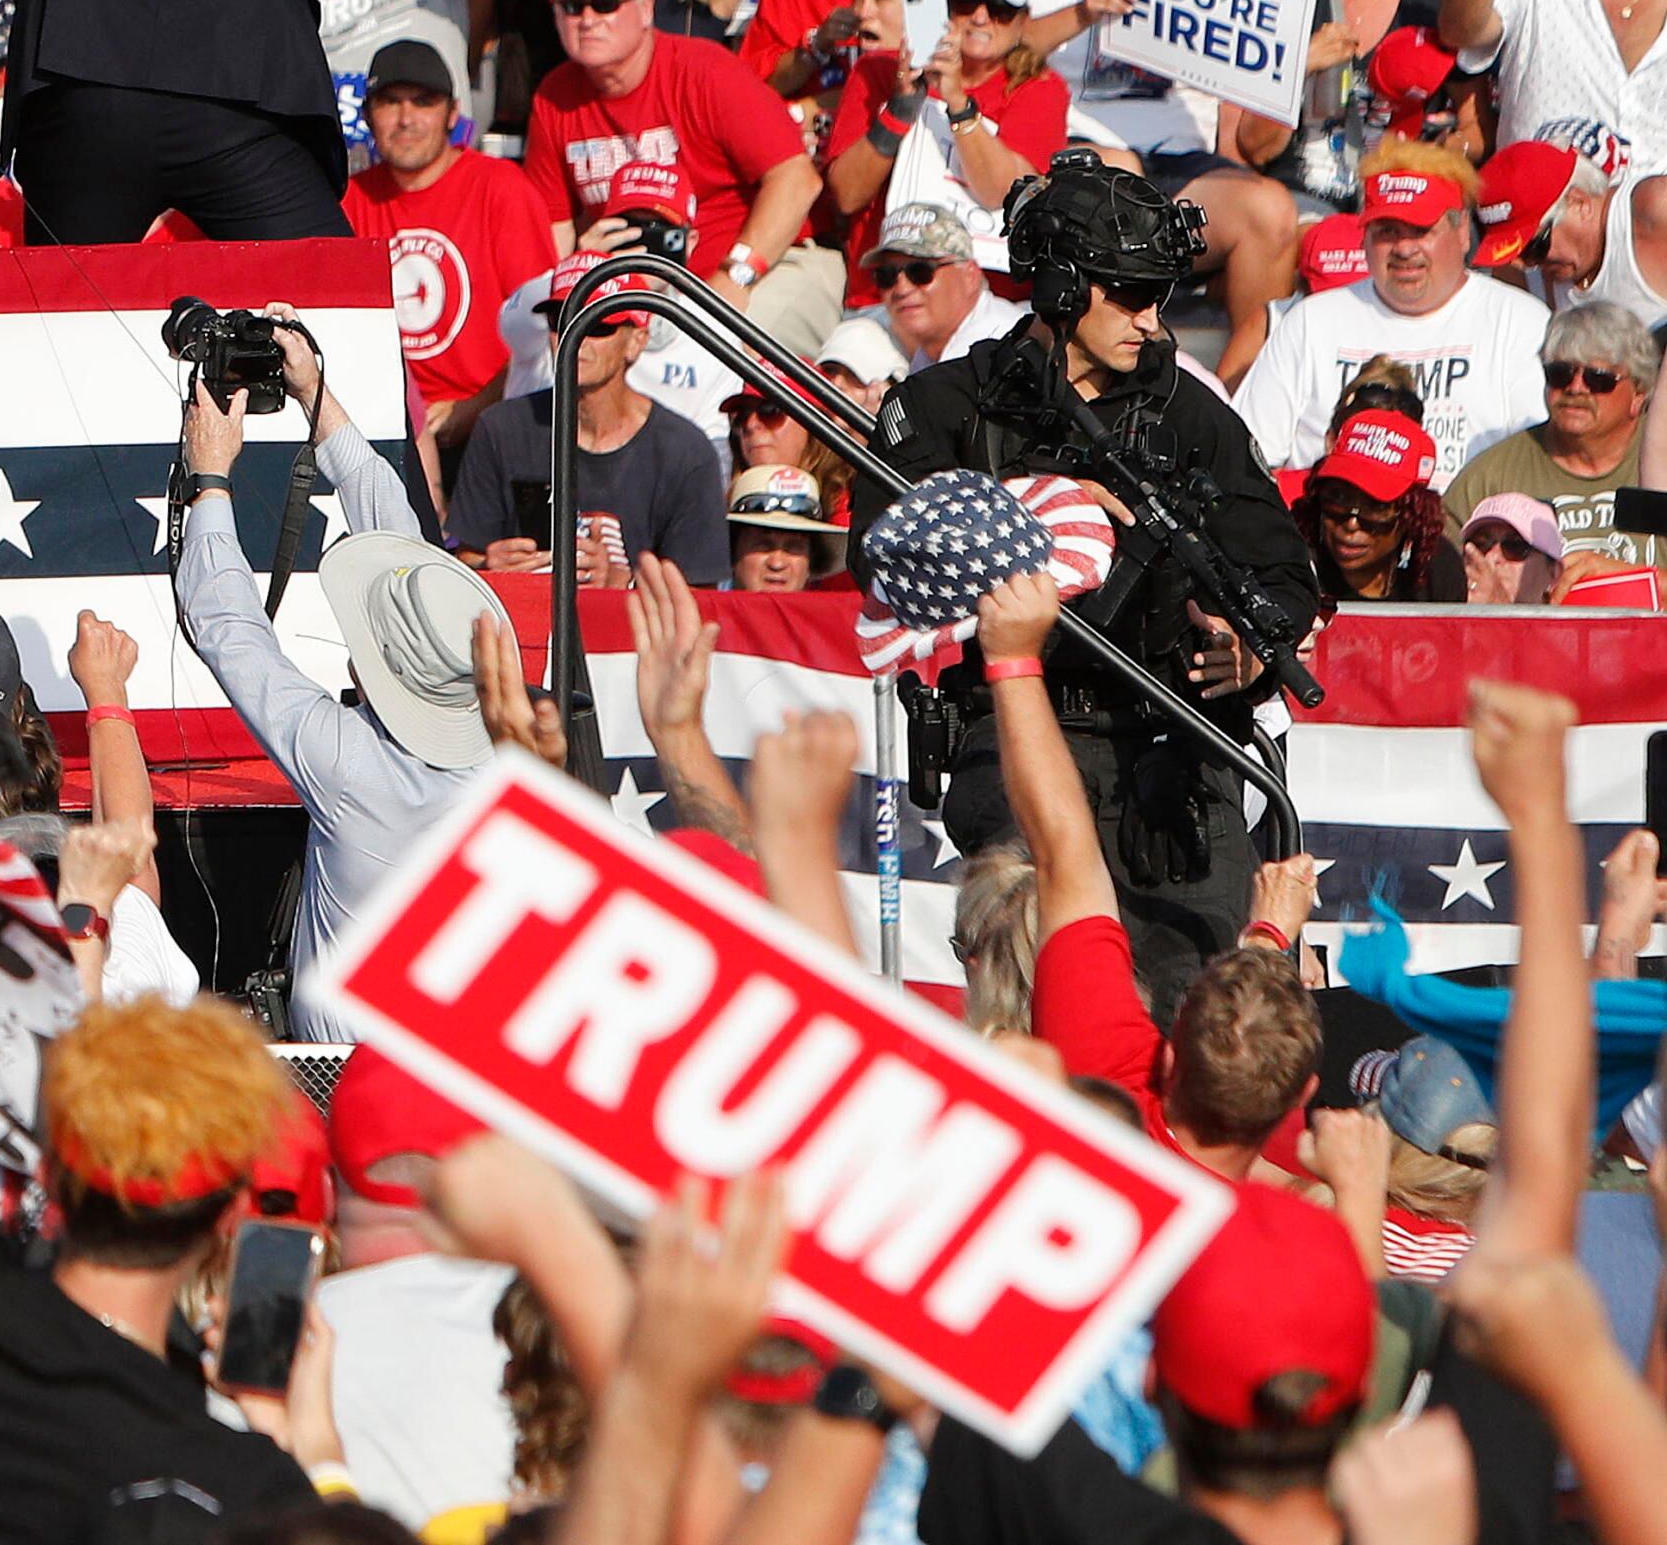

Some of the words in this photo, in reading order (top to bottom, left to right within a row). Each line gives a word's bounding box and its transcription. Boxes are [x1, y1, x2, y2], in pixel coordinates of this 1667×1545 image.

[621, 166, 679, 185] TRUMP
[1377, 173, 1429, 195] Trump
[662, 363, 698, 389] PA
[1335, 358, 1471, 401] TMP
[1352, 421, 1411, 452] MARYLAND
[1346, 437, 1404, 466] TRUMP
[410, 811, 1146, 1338] TRUMP
